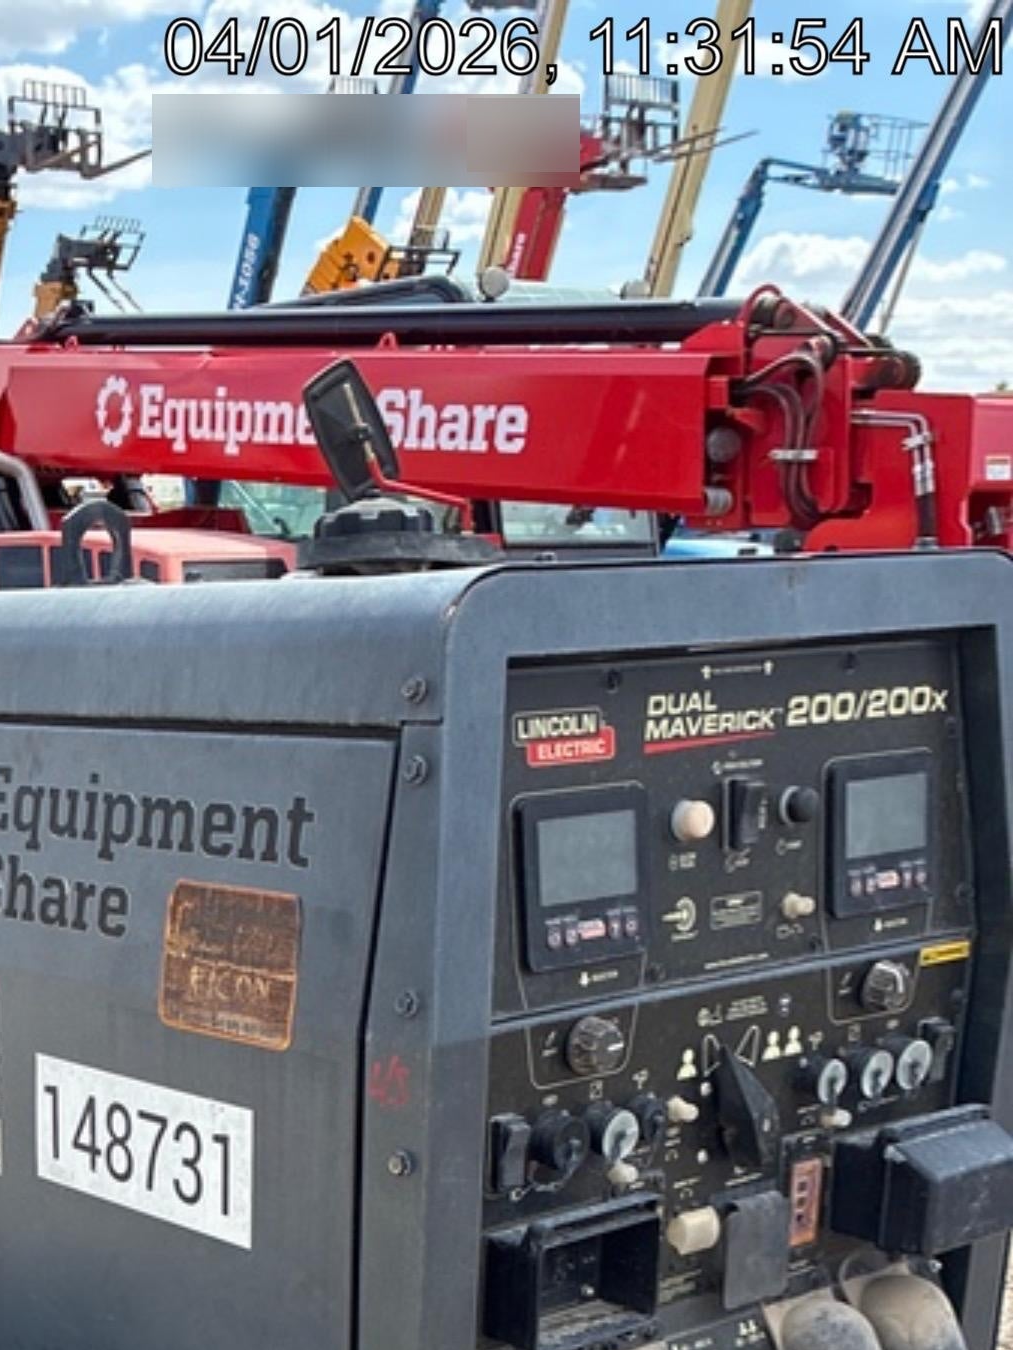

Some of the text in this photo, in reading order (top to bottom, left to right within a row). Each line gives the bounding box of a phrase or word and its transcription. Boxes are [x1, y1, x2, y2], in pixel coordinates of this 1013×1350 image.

[138, 385, 529, 455] Equipme Share
[647, 690, 718, 717] DUAL
[517, 713, 597, 739] LINCOLN
[538, 738, 606, 760] ELECTRIC
[43, 1084, 232, 1217] 148731
